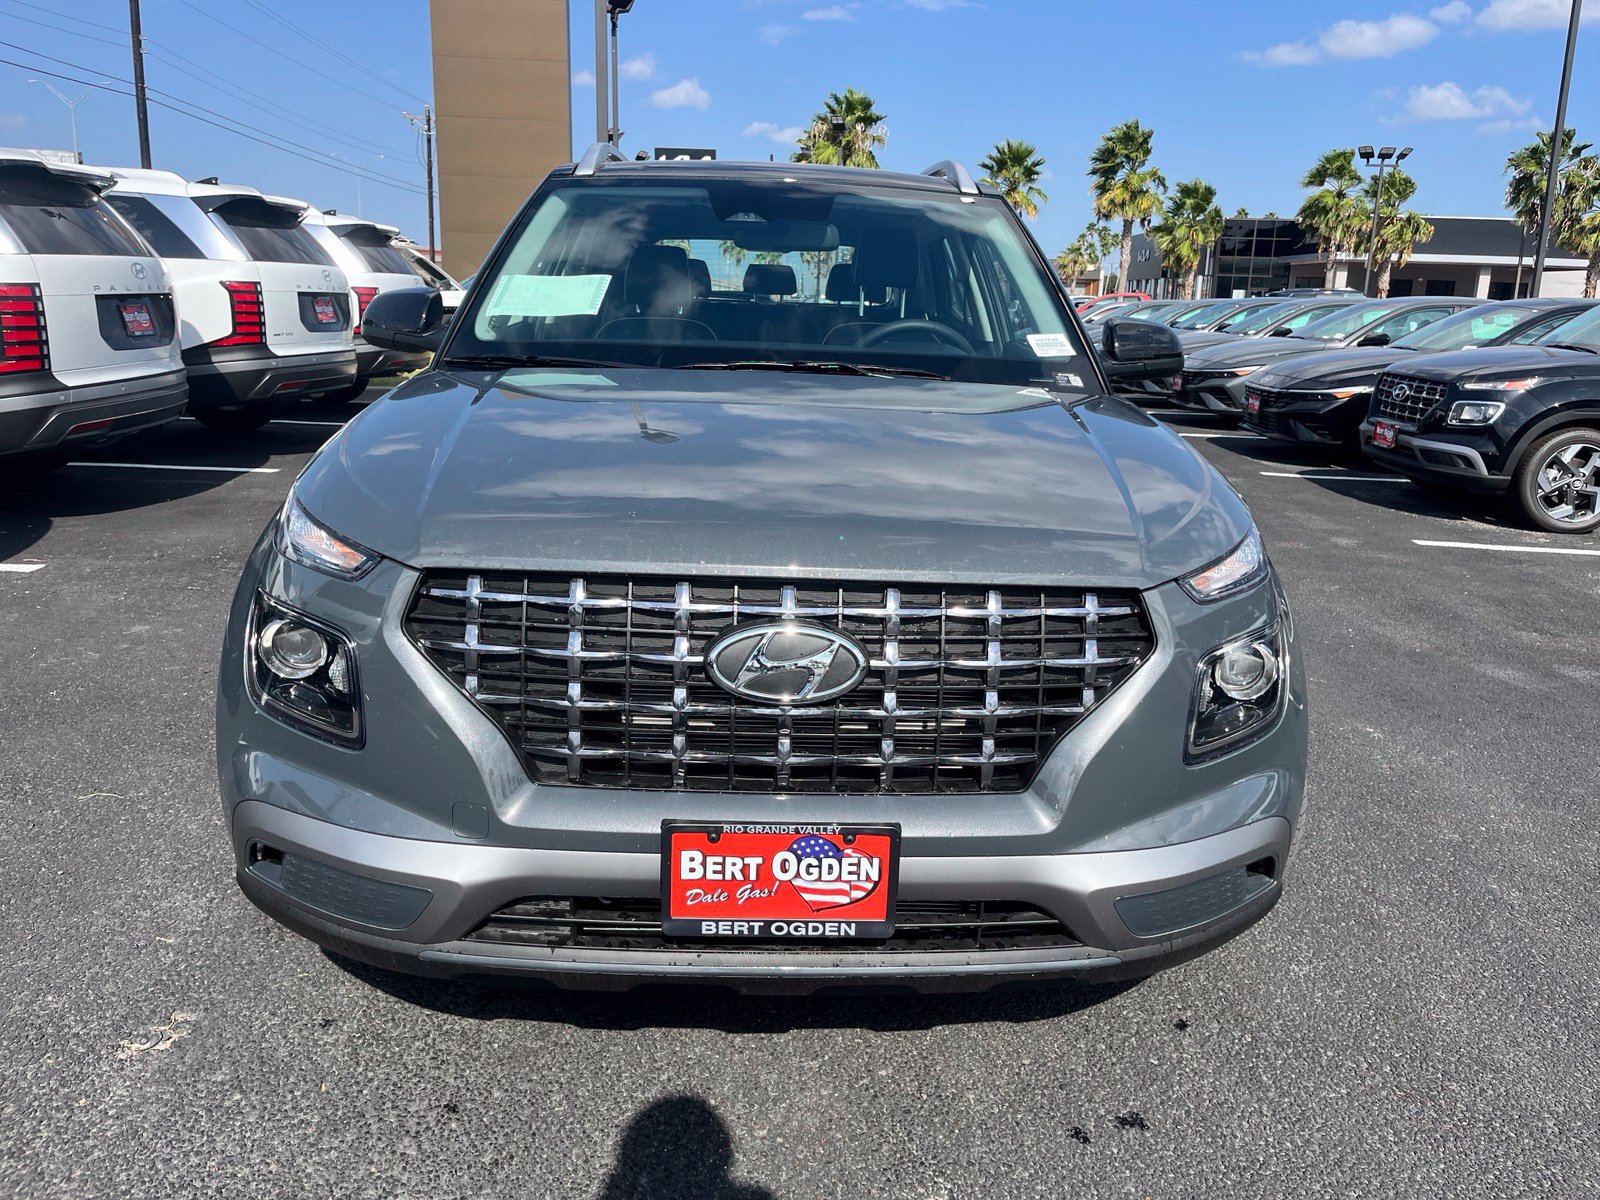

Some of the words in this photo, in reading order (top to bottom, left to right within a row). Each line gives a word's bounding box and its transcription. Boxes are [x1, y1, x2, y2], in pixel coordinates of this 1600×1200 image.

[723, 825, 744, 833] RIO
[746, 825, 796, 835] GRANDE
[797, 825, 841, 835] VALLEY
[686, 888, 728, 905] Dale
[736, 880, 779, 905] Gas!
[701, 921, 764, 935] BERT
[770, 922, 856, 936] OGDEN
